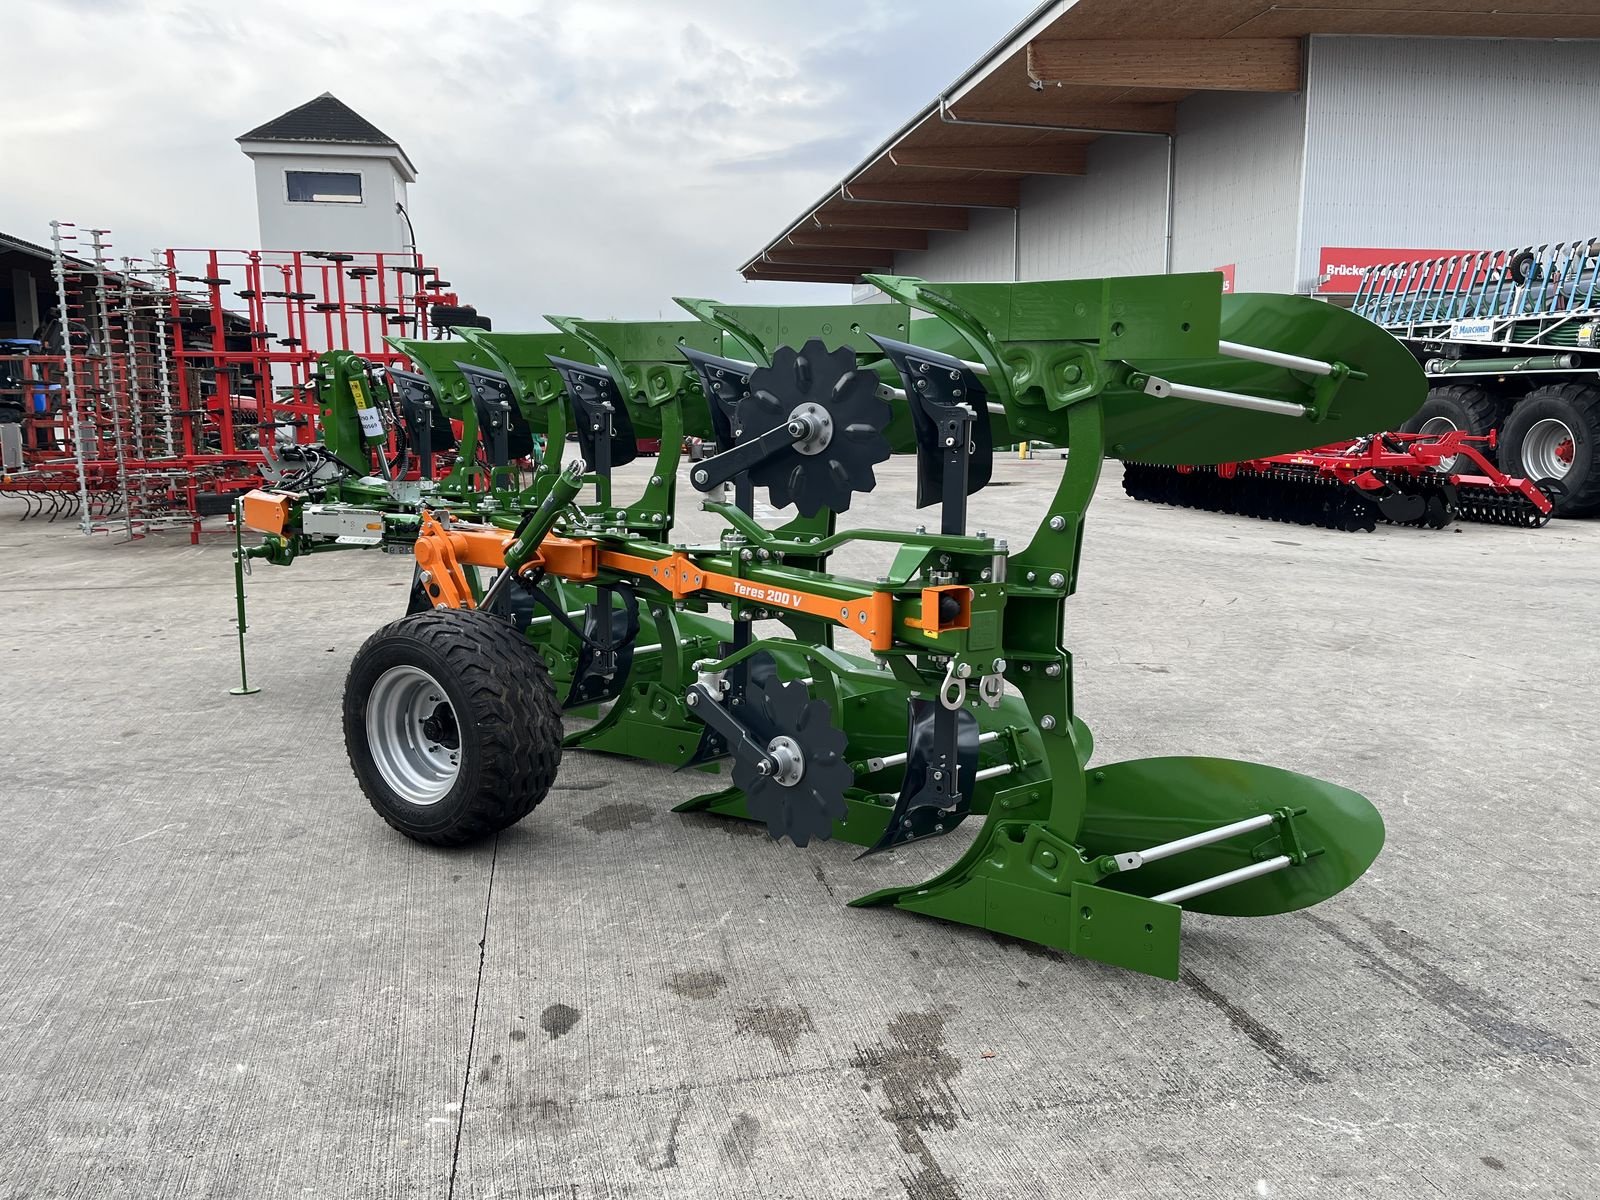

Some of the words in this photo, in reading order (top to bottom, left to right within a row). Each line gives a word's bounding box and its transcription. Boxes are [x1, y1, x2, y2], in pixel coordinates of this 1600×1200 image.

[734, 581, 765, 599] Teres
[766, 589, 790, 605] 200
[792, 594, 802, 607] V
